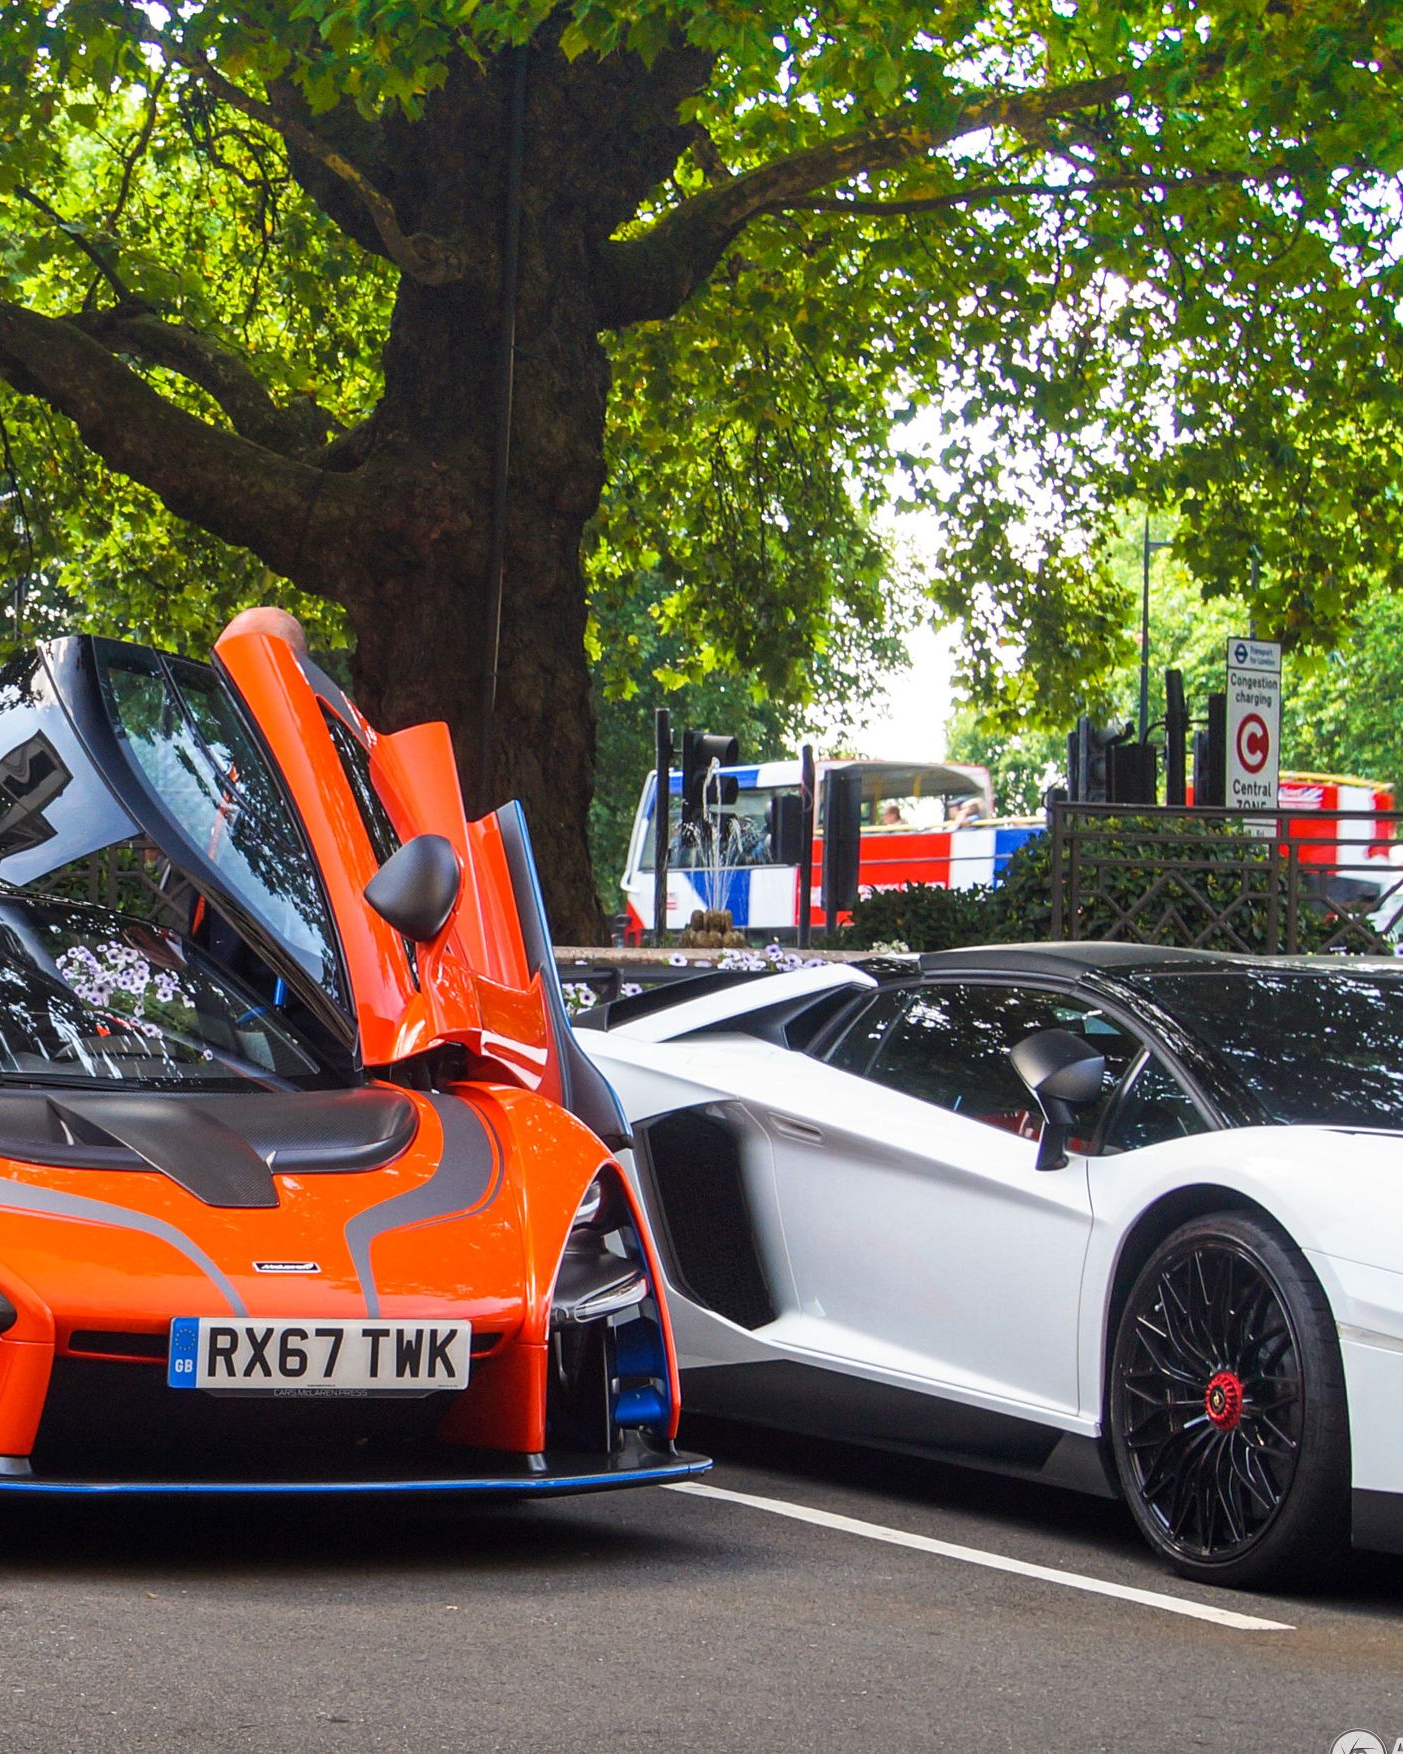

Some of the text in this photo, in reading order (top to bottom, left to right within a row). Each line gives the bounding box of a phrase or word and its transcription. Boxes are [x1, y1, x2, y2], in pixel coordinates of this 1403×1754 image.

[1230, 672, 1278, 690] Congestion
[1235, 690, 1272, 708] charging
[1232, 779, 1272, 797] Central
[207, 1327, 458, 1378] RX67 TWK
[175, 1359, 193, 1374] GB
